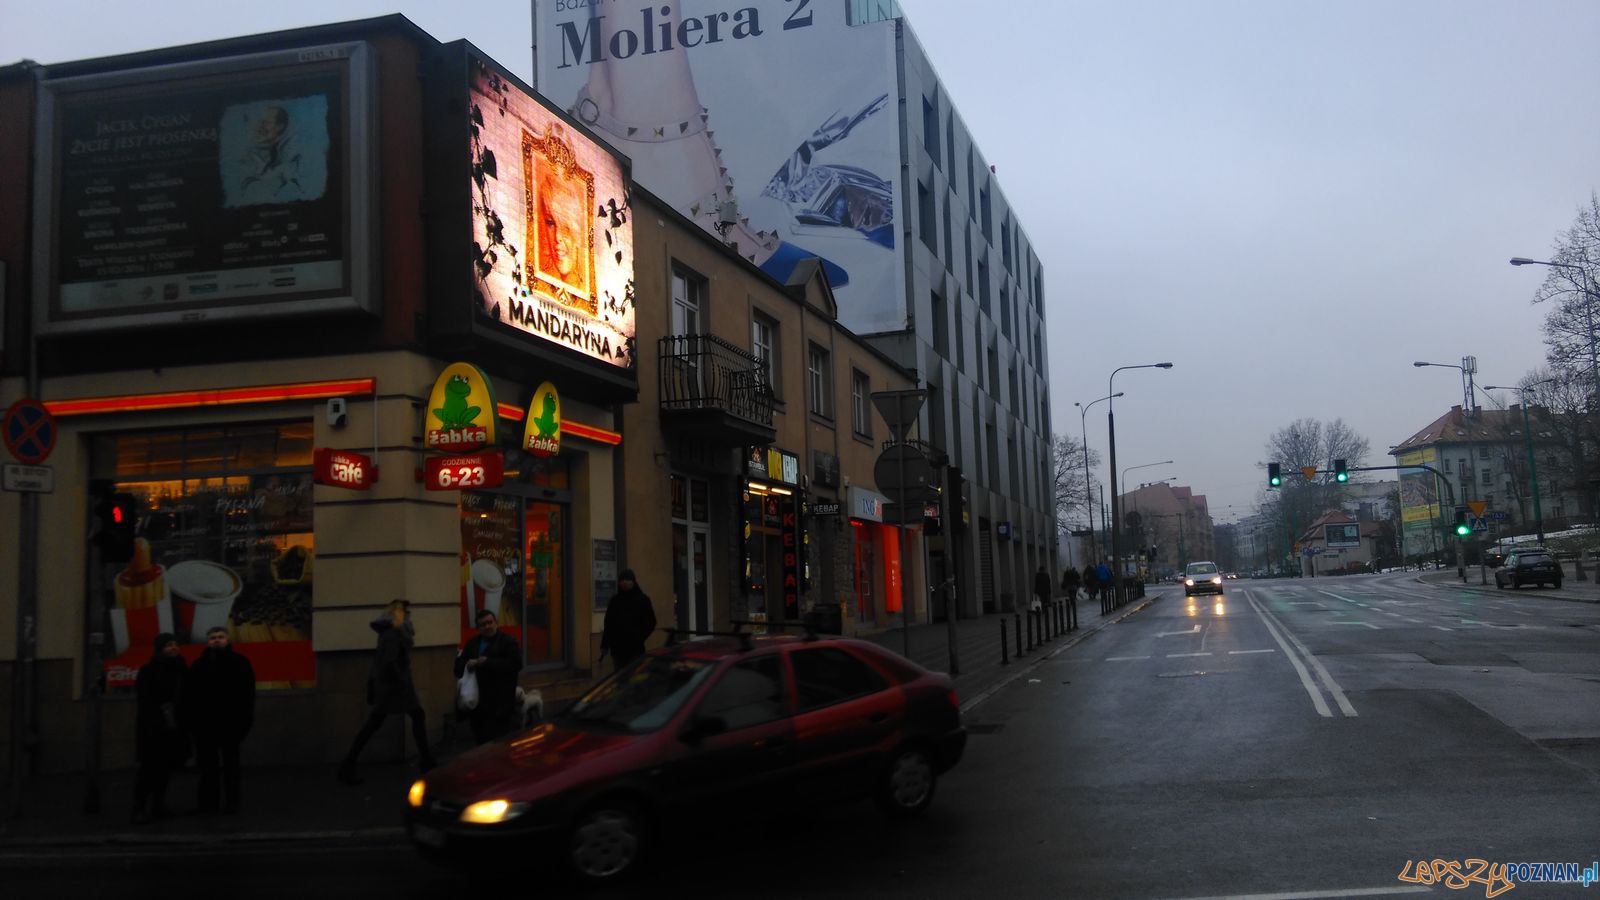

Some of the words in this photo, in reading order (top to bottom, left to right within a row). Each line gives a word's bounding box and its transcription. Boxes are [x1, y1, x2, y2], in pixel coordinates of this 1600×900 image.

[557, 5, 763, 69] Moliera
[783, 0, 813, 30] 2
[142, 112, 191, 129] CYGAN
[113, 134, 144, 152] JEST
[508, 296, 611, 360] MANDARYNA
[430, 428, 486, 445] żabka
[528, 436, 558, 453] żabka
[330, 462, 363, 485] café
[438, 466, 485, 487] 6-23
[814, 503, 839, 513] KEBAP
[783, 512, 797, 608] KEBAP
